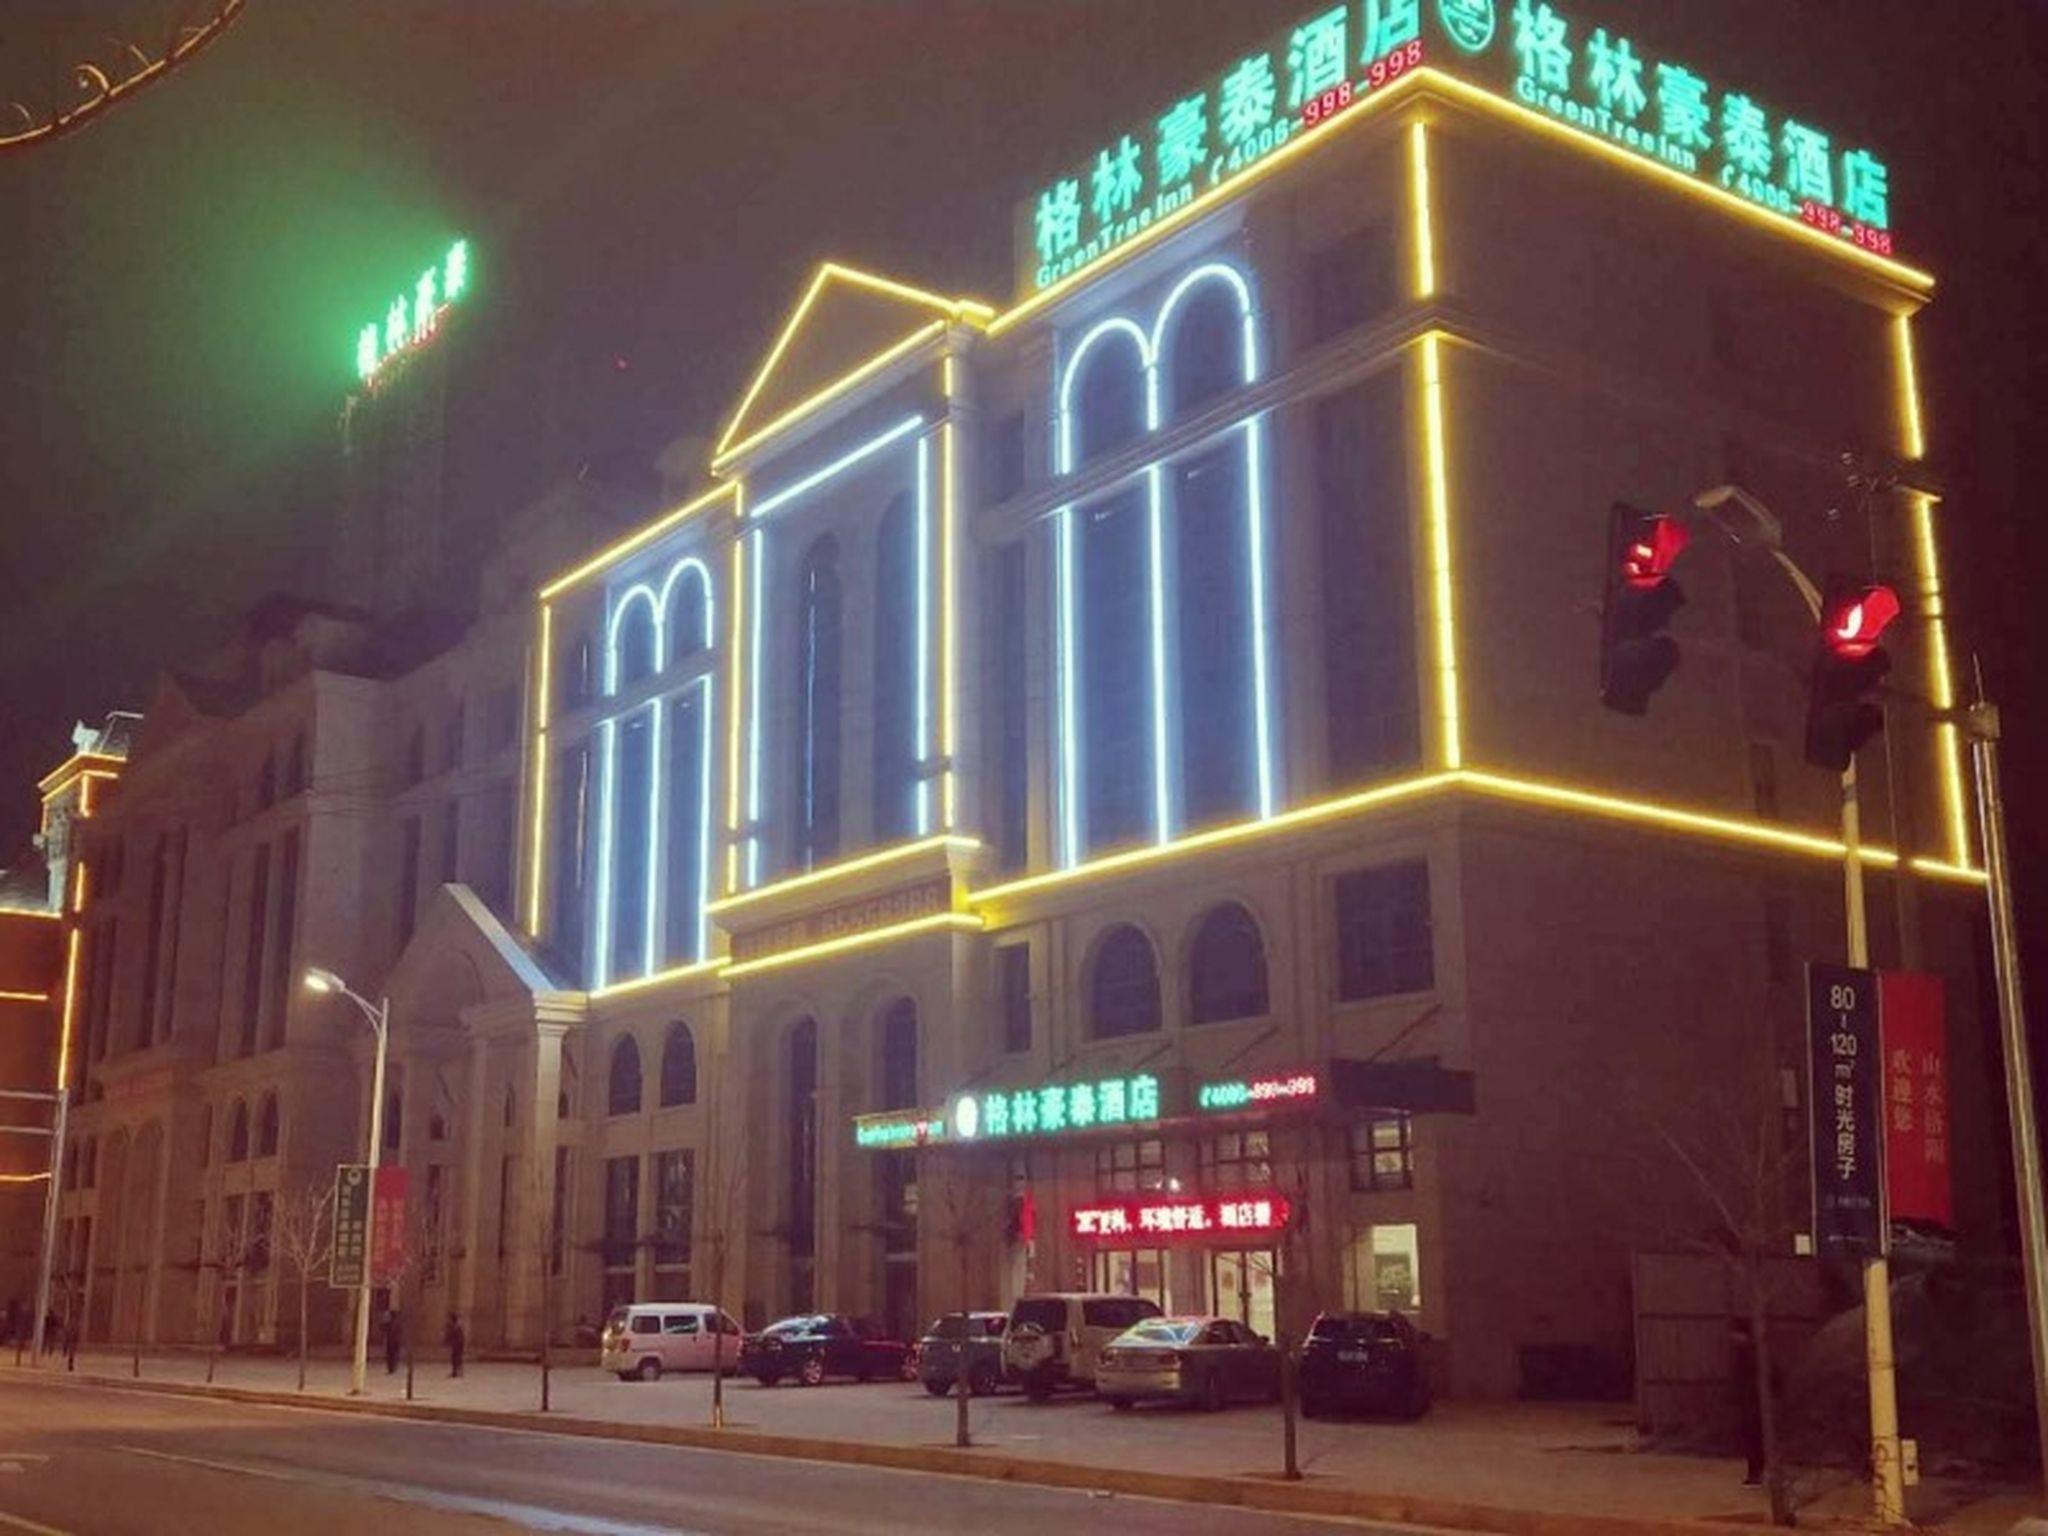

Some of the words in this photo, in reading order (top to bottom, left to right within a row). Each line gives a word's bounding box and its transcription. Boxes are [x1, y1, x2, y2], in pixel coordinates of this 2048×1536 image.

[1036, 0, 1420, 262] 格林豪泰酒店
[1512, 3, 1889, 230] 格林豪泰酒店
[985, 1074, 1159, 1135] 格林豪泰酒店
